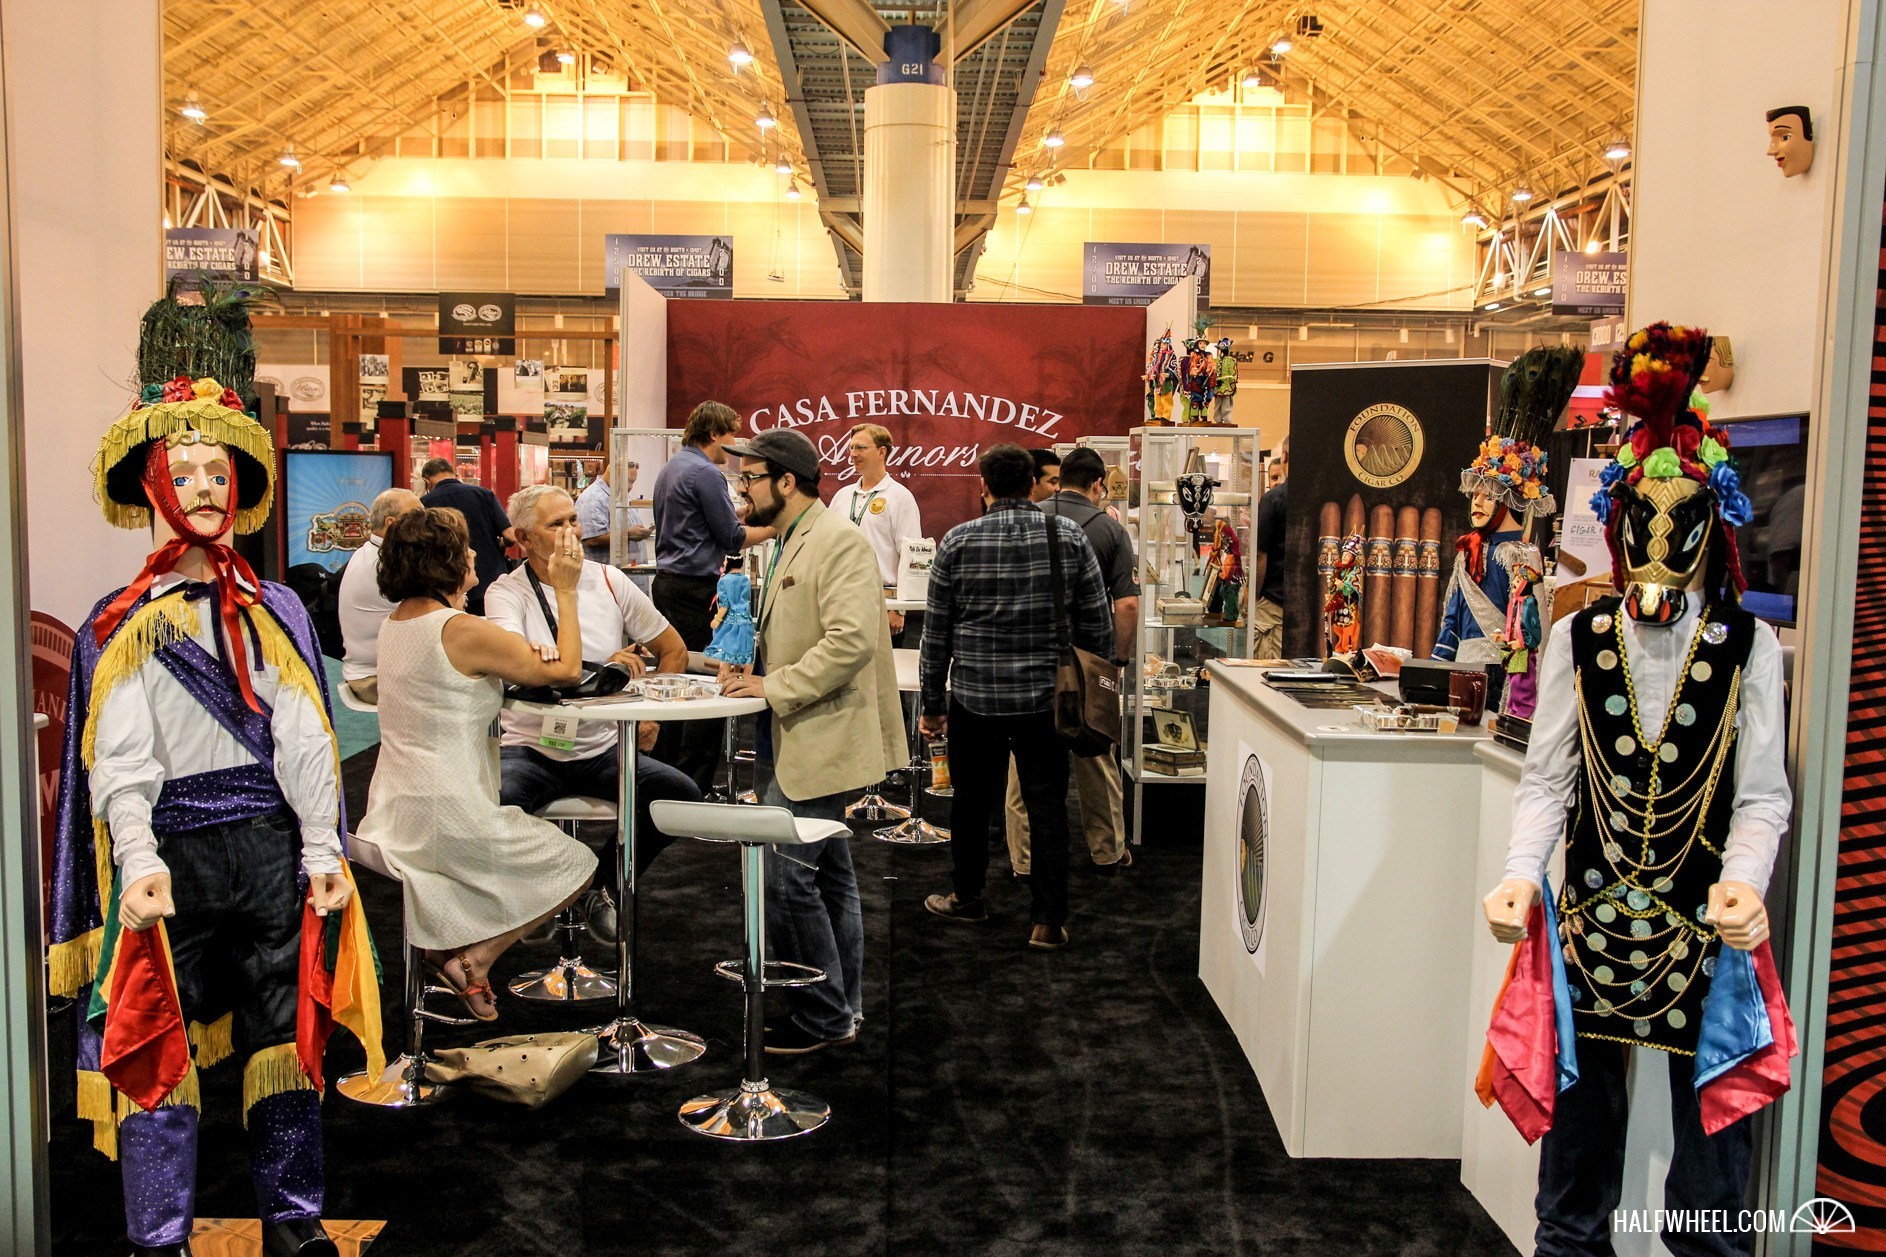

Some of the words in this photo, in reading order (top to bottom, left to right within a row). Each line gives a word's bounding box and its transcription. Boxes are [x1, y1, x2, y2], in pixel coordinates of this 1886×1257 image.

[902, 63, 923, 75] G21
[189, 247, 235, 261] ESTATE
[168, 261, 198, 270] REBIRTH
[200, 262, 208, 270] OF
[210, 262, 236, 270] CIGARS
[628, 253, 662, 267] DREW
[666, 254, 711, 268] ESTATE
[644, 268, 674, 276] REBIRTH
[675, 268, 684, 276] OF
[686, 268, 711, 277] CIGARS
[1105, 262, 1139, 275] DREW
[1143, 263, 1187, 276] ESTATE
[1106, 275, 1120, 284] THE
[1121, 276, 1151, 284] REBIRTH
[1152, 276, 1161, 284] OF
[1576, 271, 1609, 284] DREW
[1576, 284, 1589, 293] THE
[1592, 285, 1620, 293] REBIRTH
[1263, 351, 1274, 363] G
[749, 395, 839, 435] CASA
[845, 389, 1064, 439] FERNANDEZ
[1350, 404, 1420, 433] FOUNDATION
[1358, 472, 1386, 486] CIGAR
[1571, 525, 1597, 535] CIGAR
